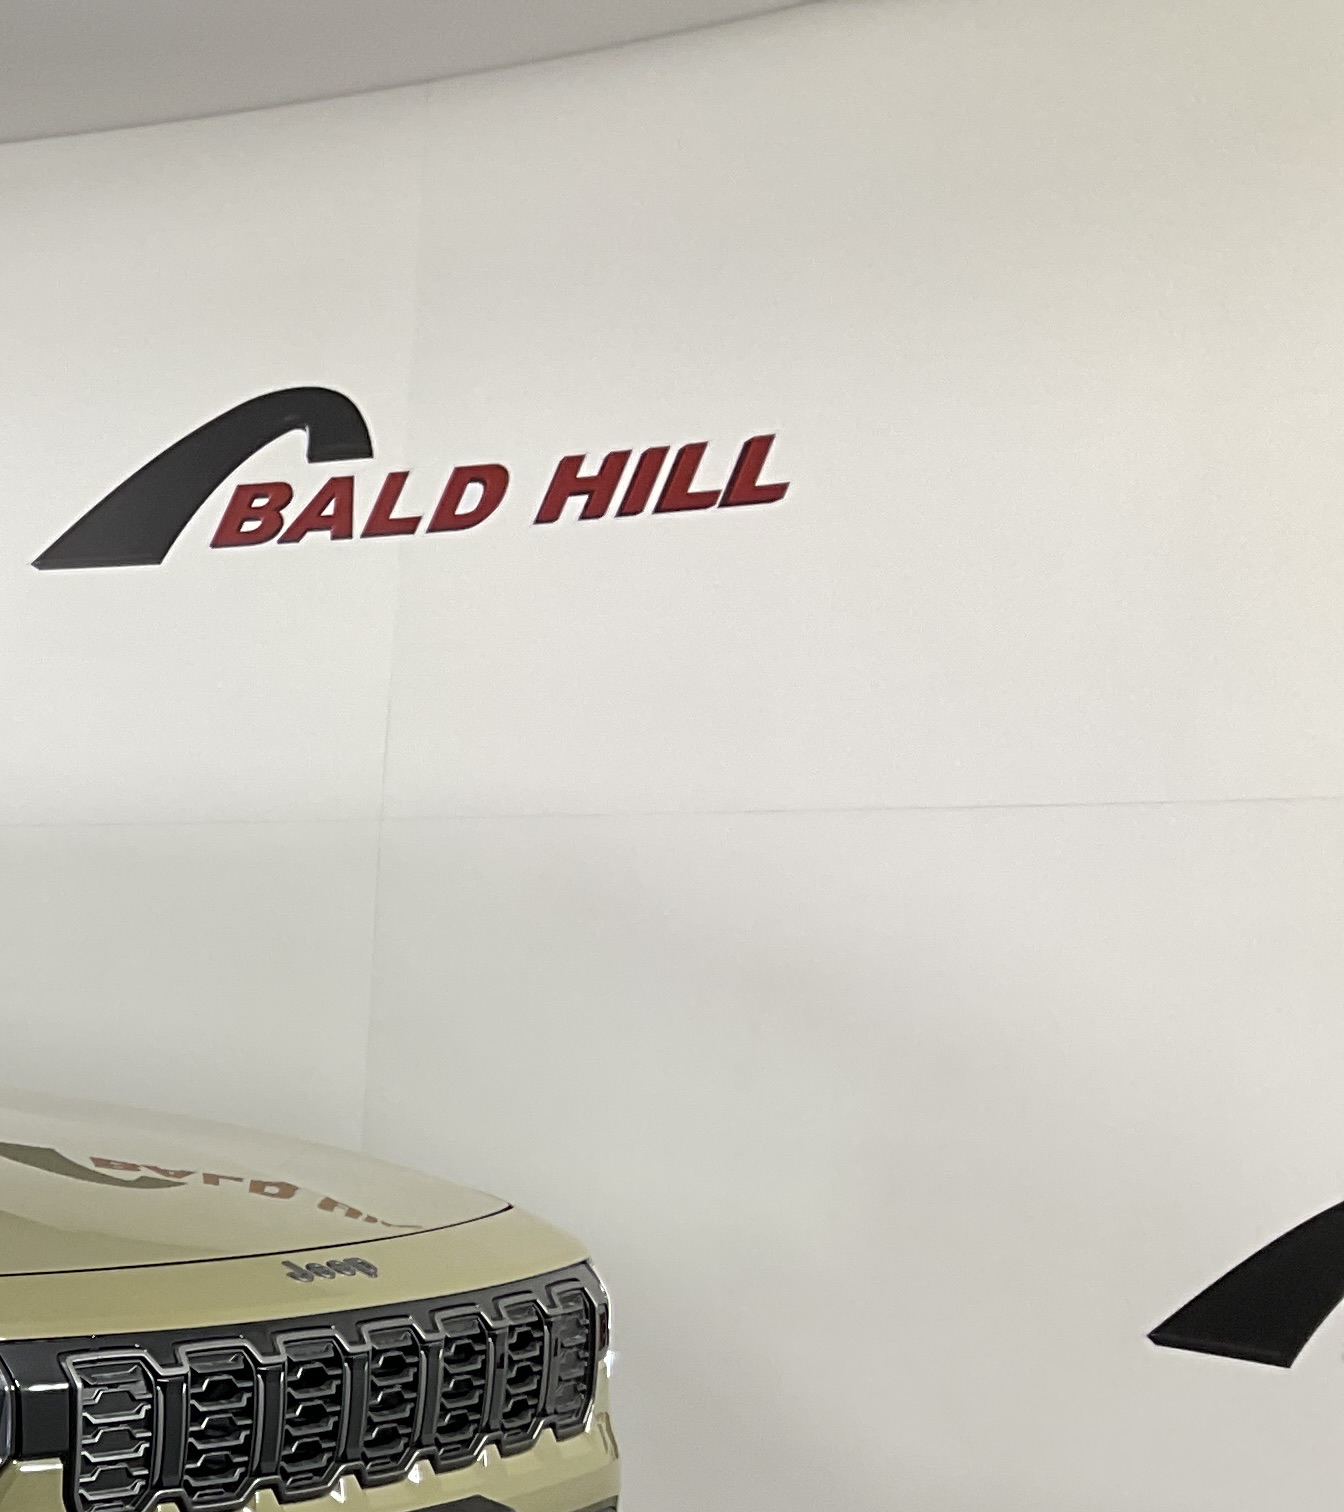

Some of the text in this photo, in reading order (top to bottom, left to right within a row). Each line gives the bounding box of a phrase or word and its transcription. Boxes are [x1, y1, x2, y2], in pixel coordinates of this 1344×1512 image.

[209, 434, 791, 550] BALD HILL
[280, 1257, 378, 1283] Jeep
